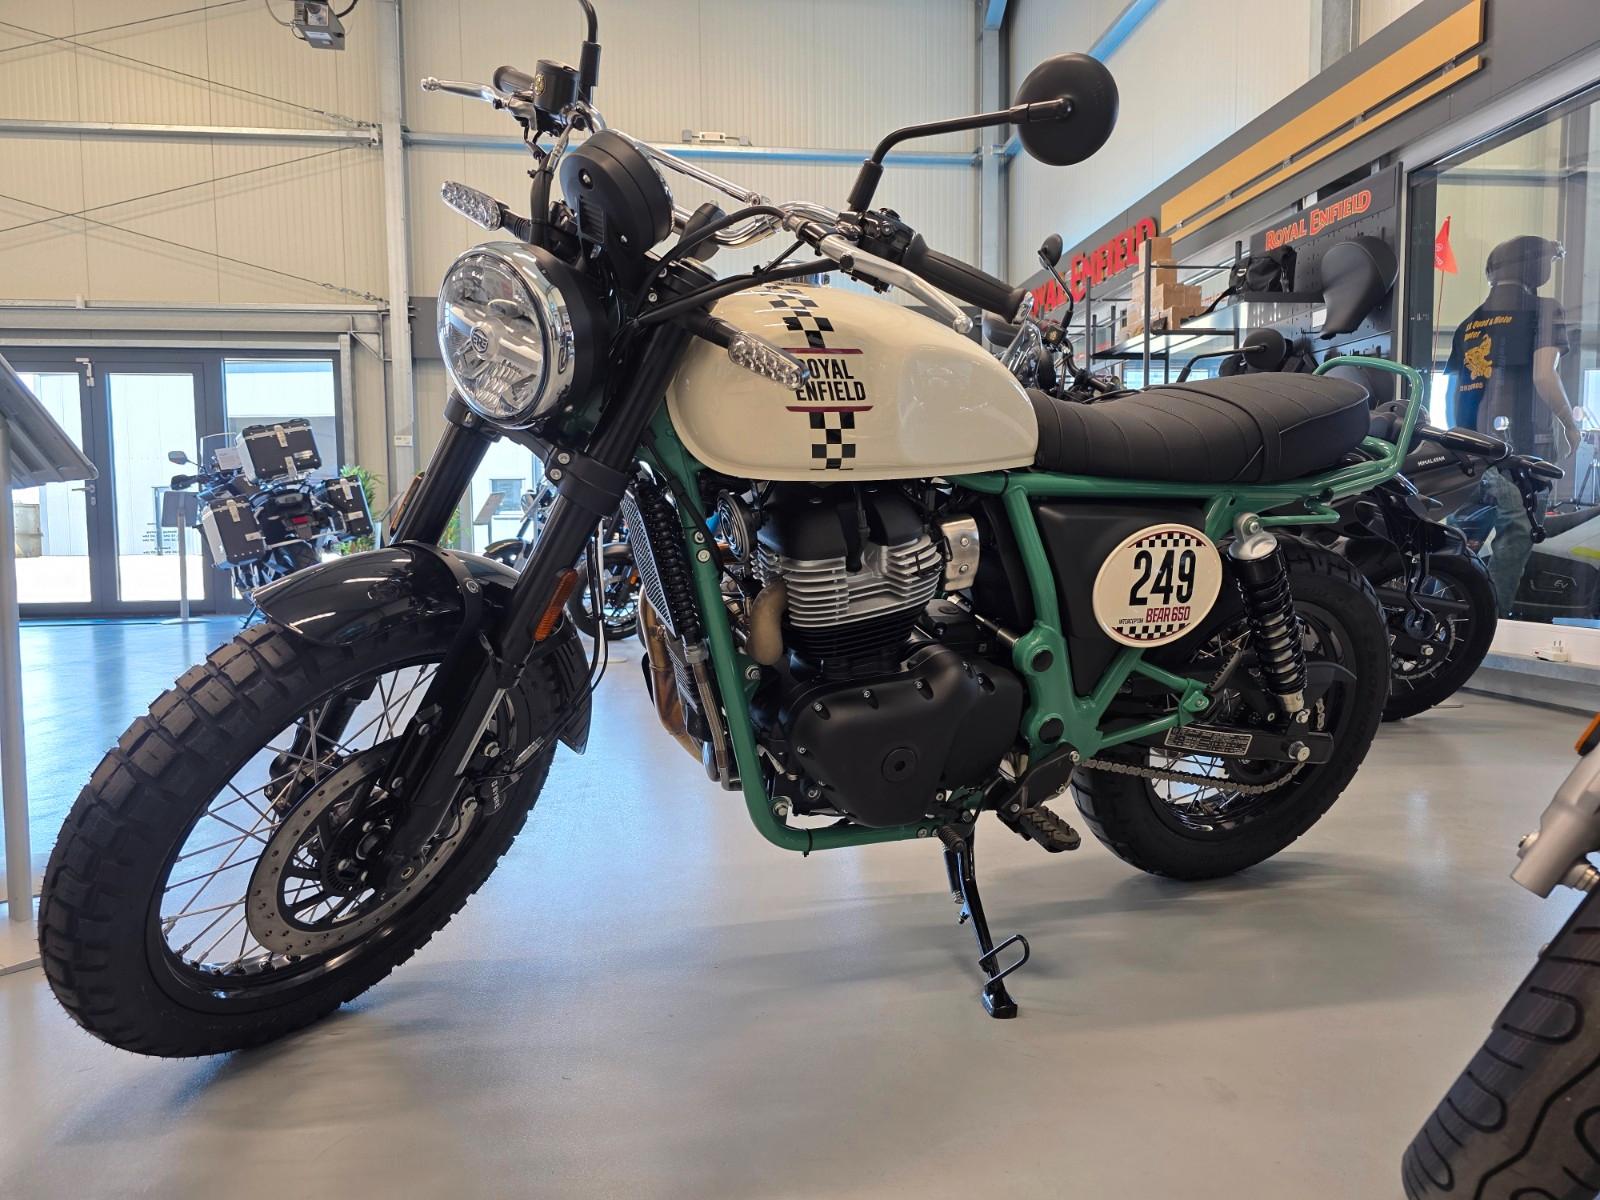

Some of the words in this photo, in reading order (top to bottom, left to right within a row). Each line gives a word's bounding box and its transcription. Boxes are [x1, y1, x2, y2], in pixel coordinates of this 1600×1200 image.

[1265, 219, 1307, 252] ROYAL
[1310, 189, 1372, 236] ENFIELD
[1128, 549, 1197, 607] 249
[1146, 608, 1171, 623] BEAR
[1171, 605, 1191, 622] 650
